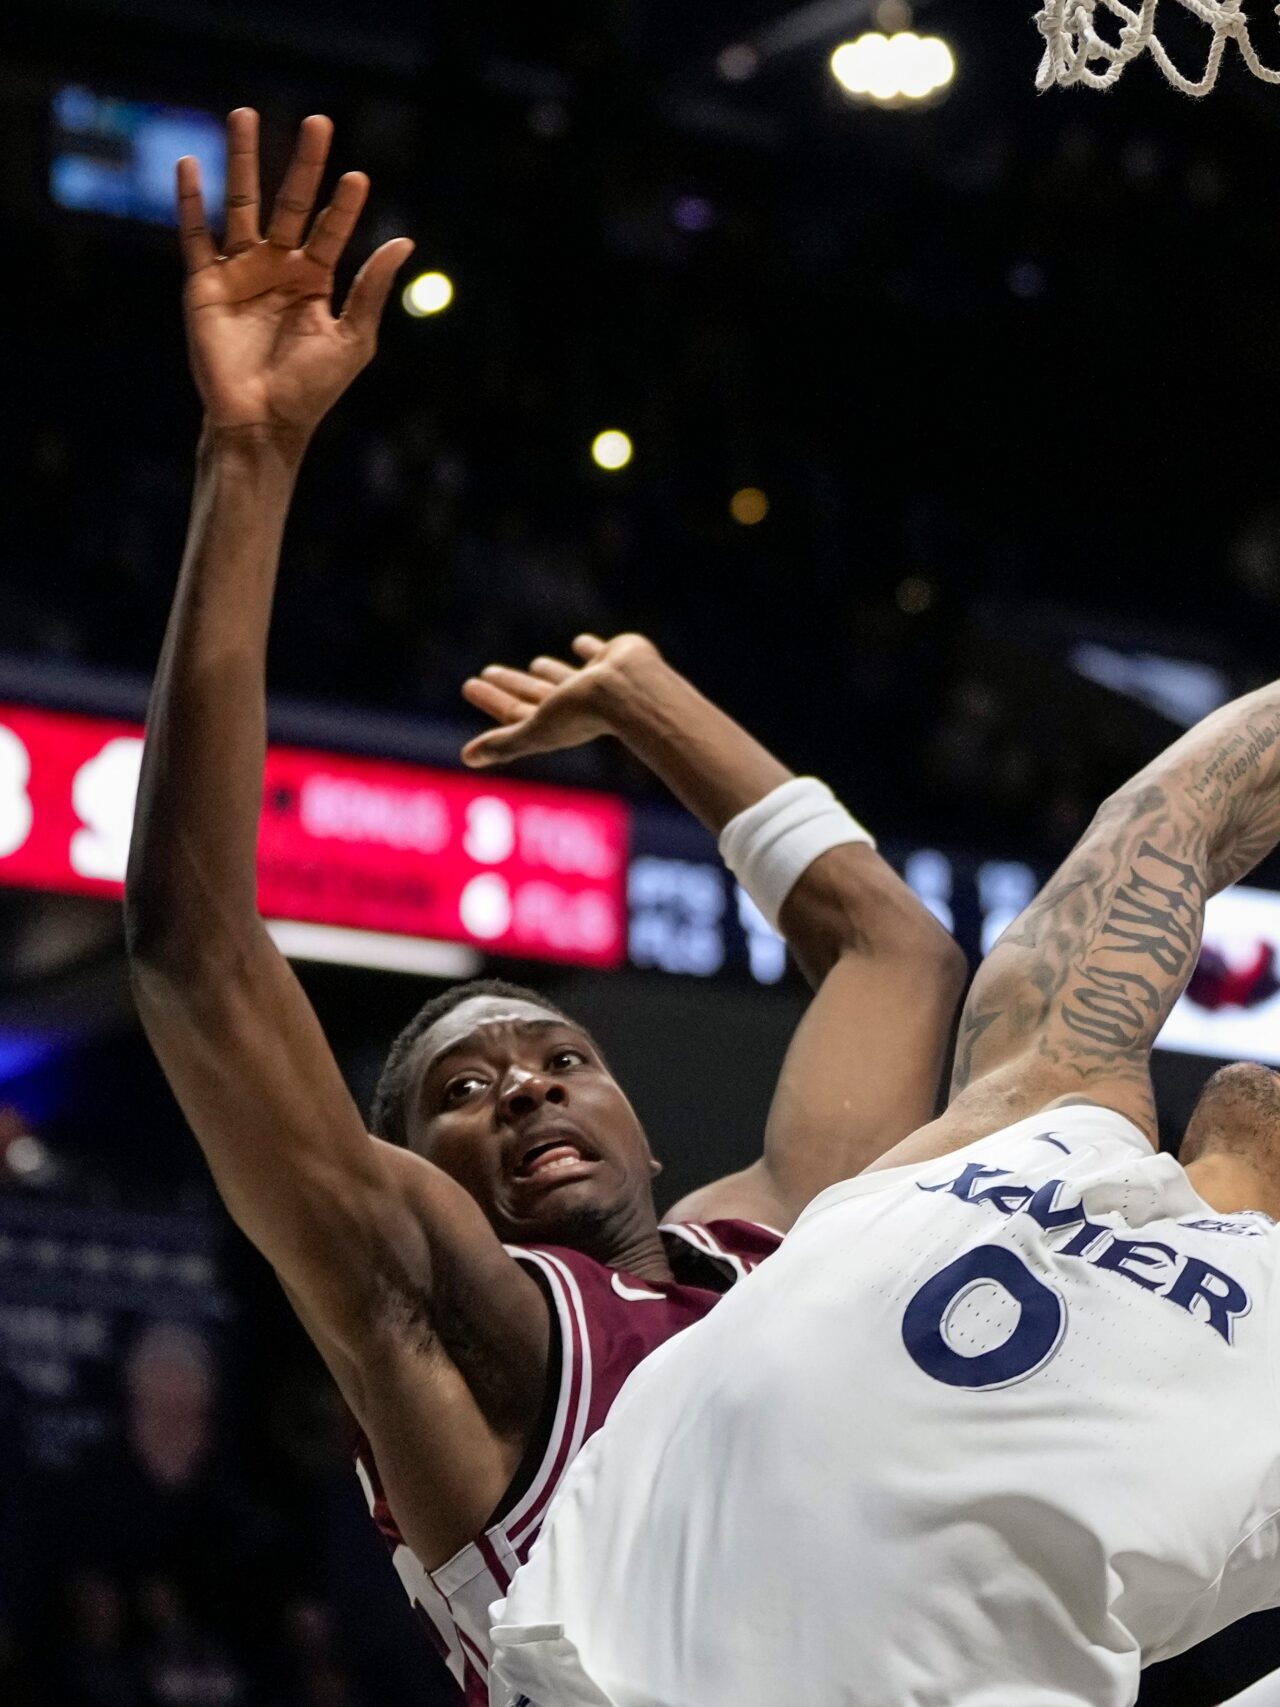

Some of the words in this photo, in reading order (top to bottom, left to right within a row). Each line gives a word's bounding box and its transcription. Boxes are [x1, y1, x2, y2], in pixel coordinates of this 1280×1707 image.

[1092, 840, 1206, 977] FEAR
[1061, 962, 1161, 1048] GOD
[901, 1244, 1068, 1391] 0
[915, 1162, 1252, 1347] XAVIER
